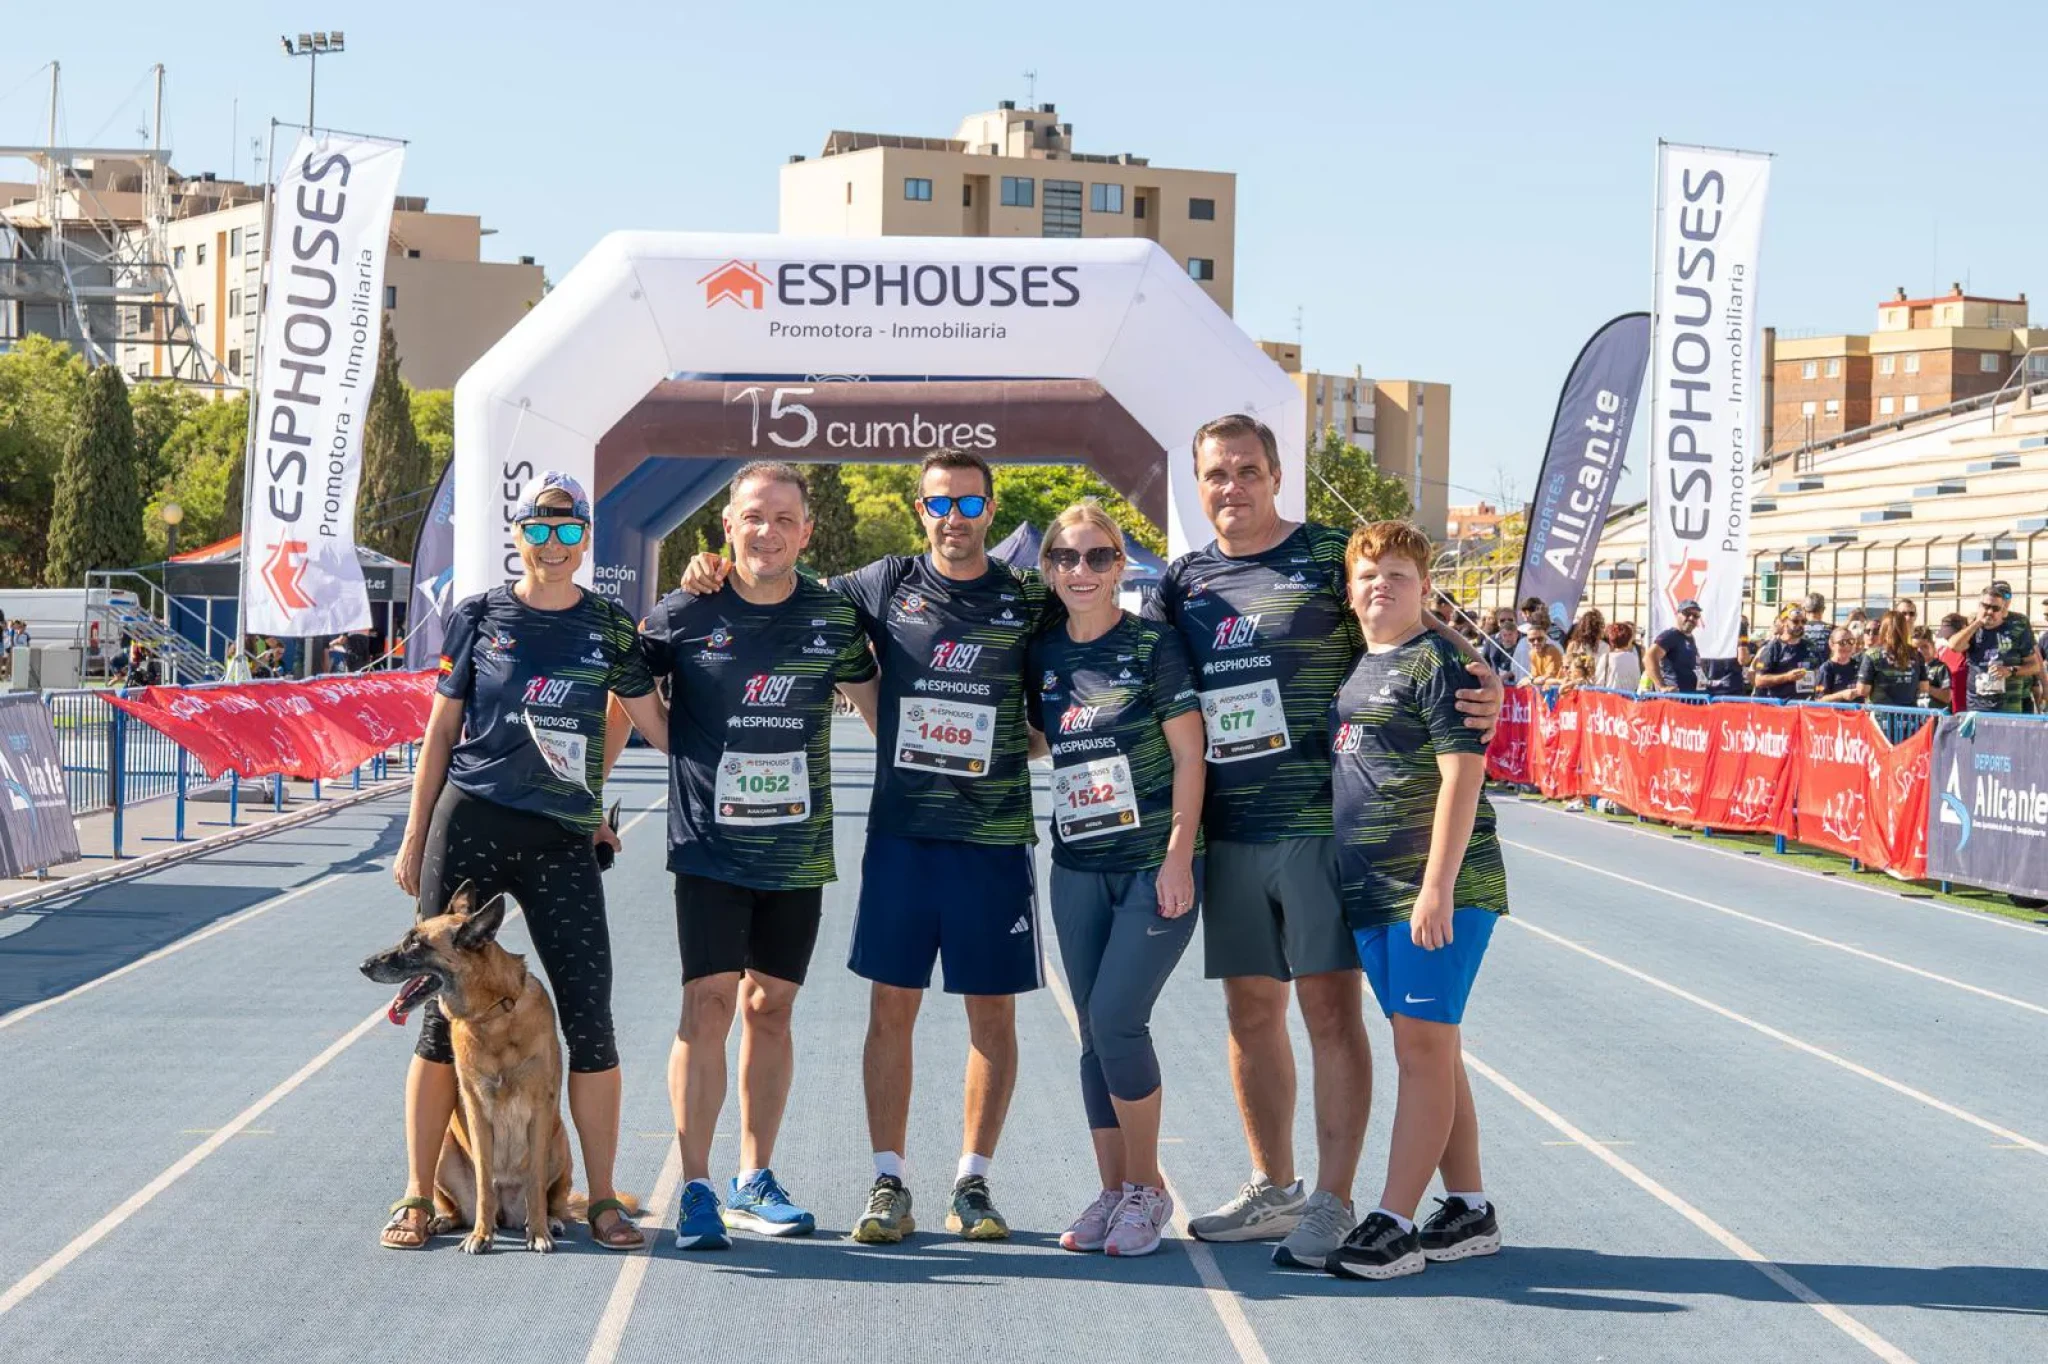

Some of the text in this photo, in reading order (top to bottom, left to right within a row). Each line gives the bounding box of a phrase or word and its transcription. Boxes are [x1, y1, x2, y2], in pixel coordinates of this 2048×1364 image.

[777, 263, 1080, 307] ESPHOUSES
[266, 151, 352, 523] ESPHOUSES
[769, 321, 873, 339] Promotora
[892, 321, 1007, 339] Inmobiliaria
[1725, 263, 1745, 402] Inmobiliaria
[1668, 168, 1725, 541] ESPHOUSES
[320, 412, 352, 537] Promotora
[340, 248, 374, 389] Inmobiliaria
[732, 387, 998, 449] 15 cumbres
[1544, 389, 1620, 578] Alicante
[1721, 421, 1745, 552] Promotora
[1530, 473, 1566, 566] DEPORTES
[595, 564, 636, 581] ación
[598, 580, 621, 595] pol
[1214, 655, 1272, 673] ESPHOUSES
[927, 679, 990, 696] ESPHOUSES
[520, 713, 580, 730] EPHOUSES
[743, 716, 804, 730] ESPHOUSES
[1220, 709, 1255, 731] 677
[918, 722, 972, 745] 1469
[1060, 736, 1116, 754] ESPHOUSES
[736, 775, 790, 793] 1052
[1068, 784, 1115, 809] 1522
[1973, 773, 2048, 825] Alicante
